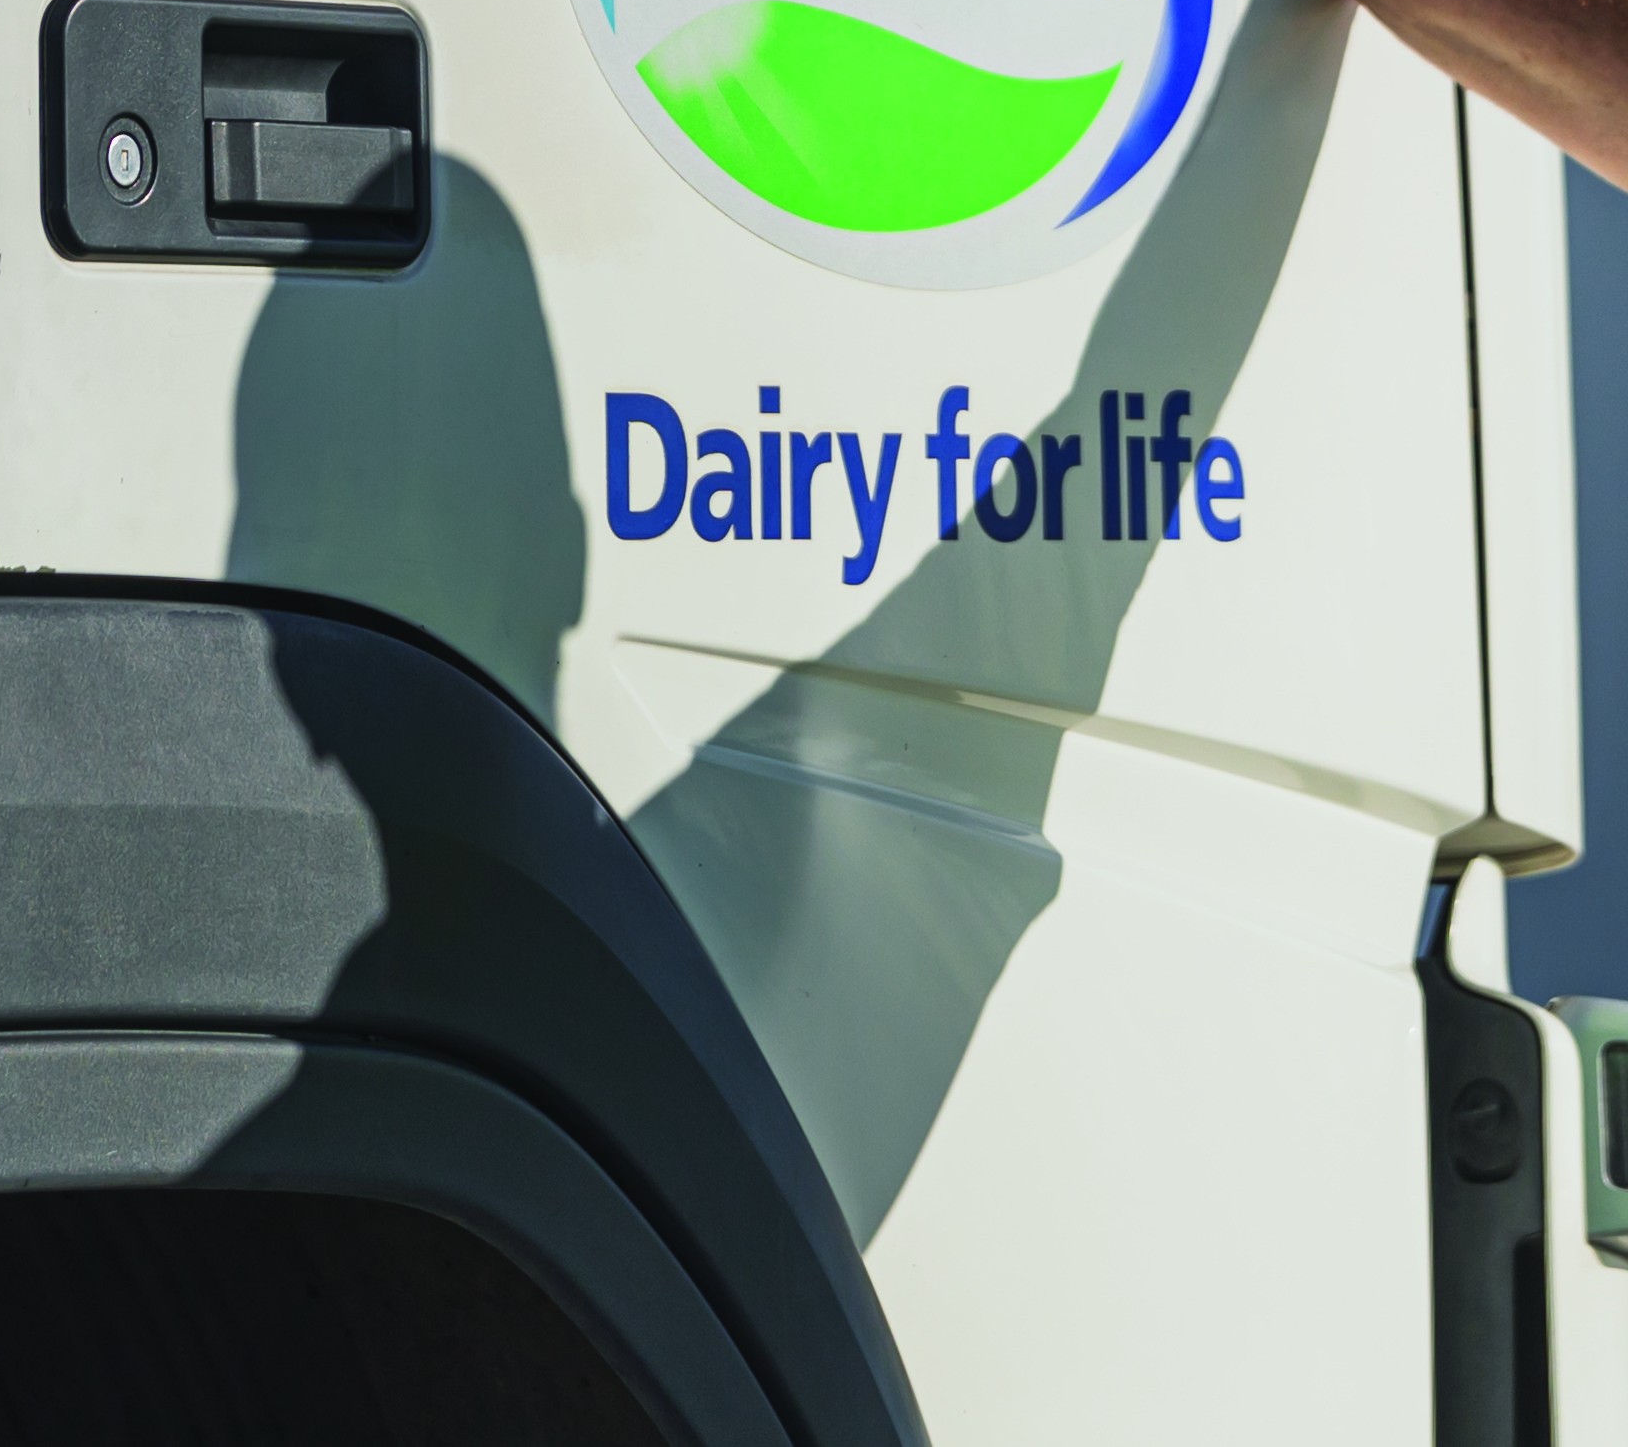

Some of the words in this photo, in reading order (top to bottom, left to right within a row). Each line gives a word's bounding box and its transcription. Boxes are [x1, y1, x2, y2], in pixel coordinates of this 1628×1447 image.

[604, 385, 902, 586] Dairy
[925, 385, 1083, 543] for
[1100, 388, 1245, 543] life
